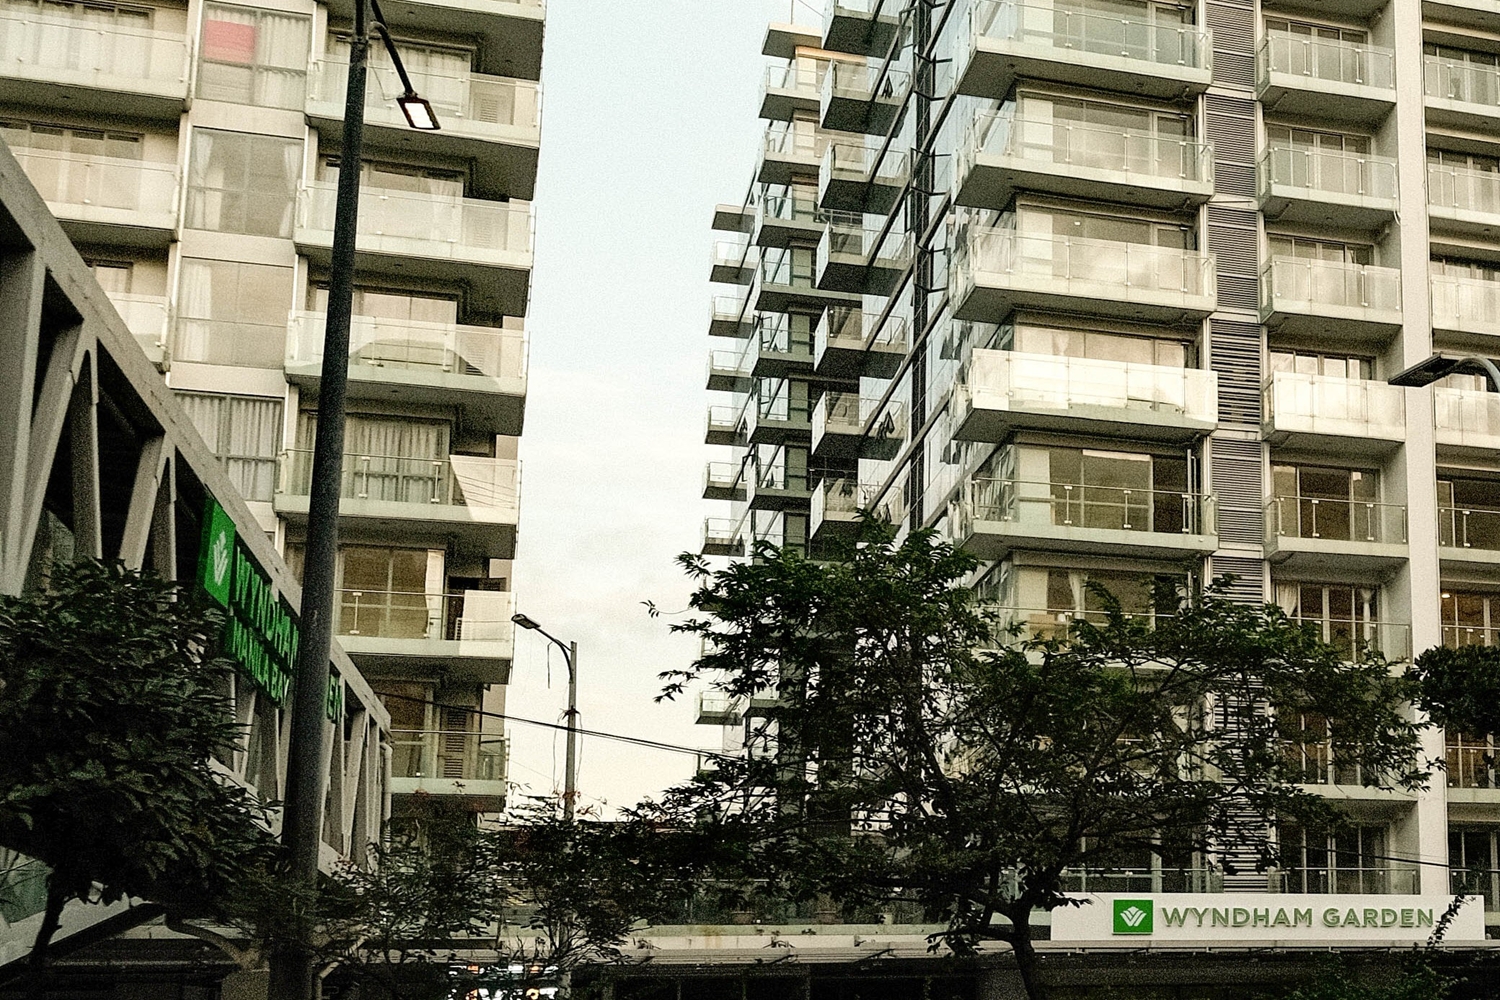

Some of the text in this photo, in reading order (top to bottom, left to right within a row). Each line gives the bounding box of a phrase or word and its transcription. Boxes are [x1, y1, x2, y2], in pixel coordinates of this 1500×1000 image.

[232, 616, 290, 708] MANILA BAY
[1162, 906, 1434, 928] WYNDHAM GARDEN
